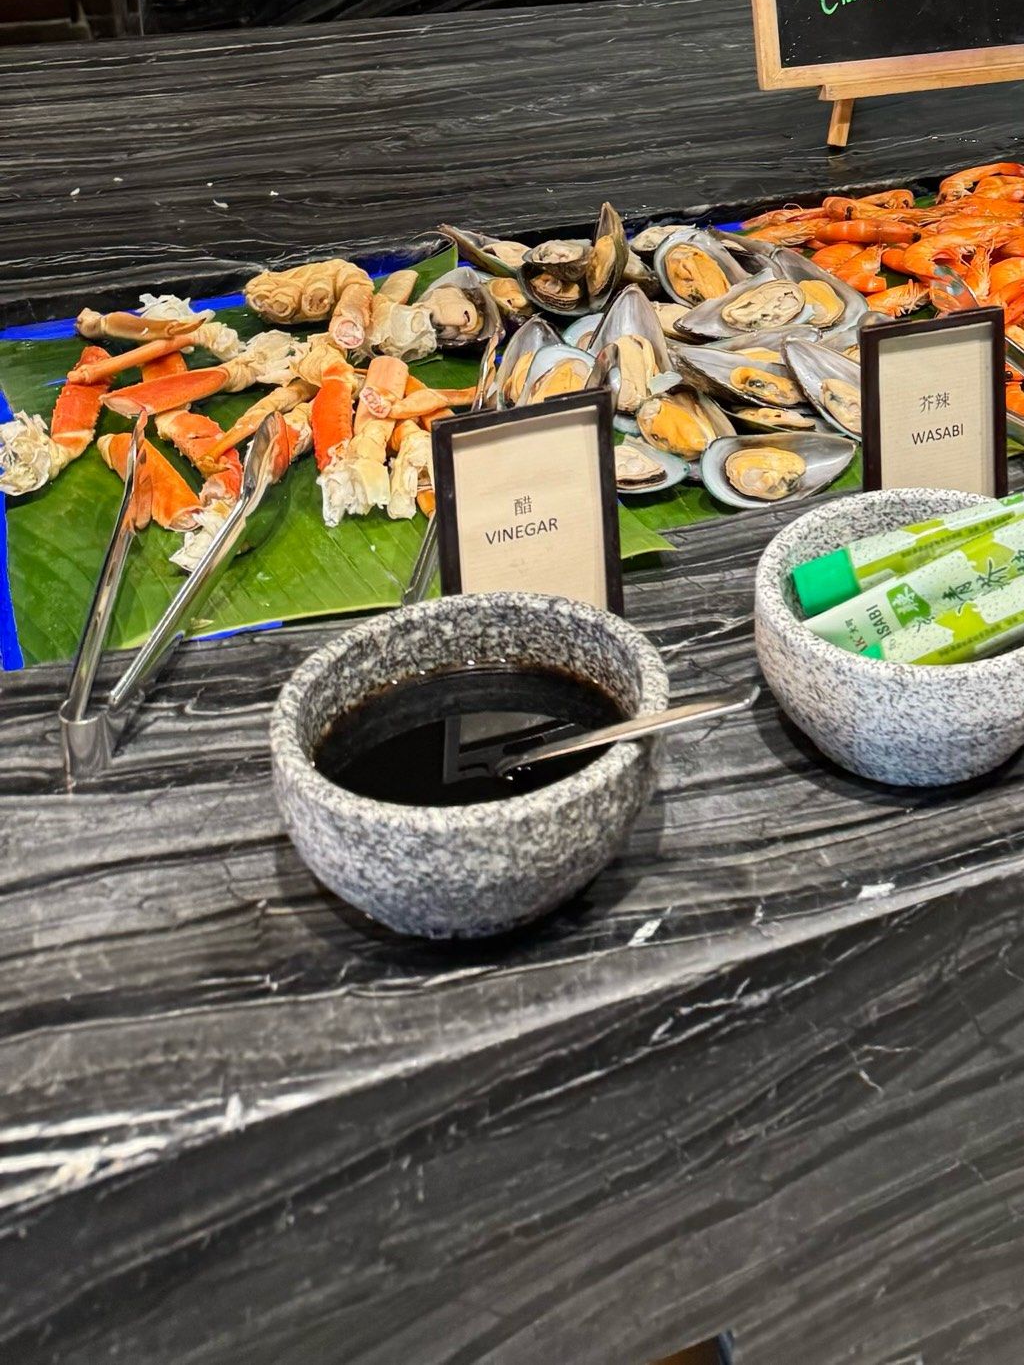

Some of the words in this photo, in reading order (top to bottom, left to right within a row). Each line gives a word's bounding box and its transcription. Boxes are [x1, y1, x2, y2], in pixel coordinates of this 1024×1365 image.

[919, 392, 951, 414] 芥辣
[911, 423, 964, 446] WASABI
[514, 495, 533, 516] 醋
[485, 517, 559, 546] VINEGAR
[866, 604, 893, 640] SABI
